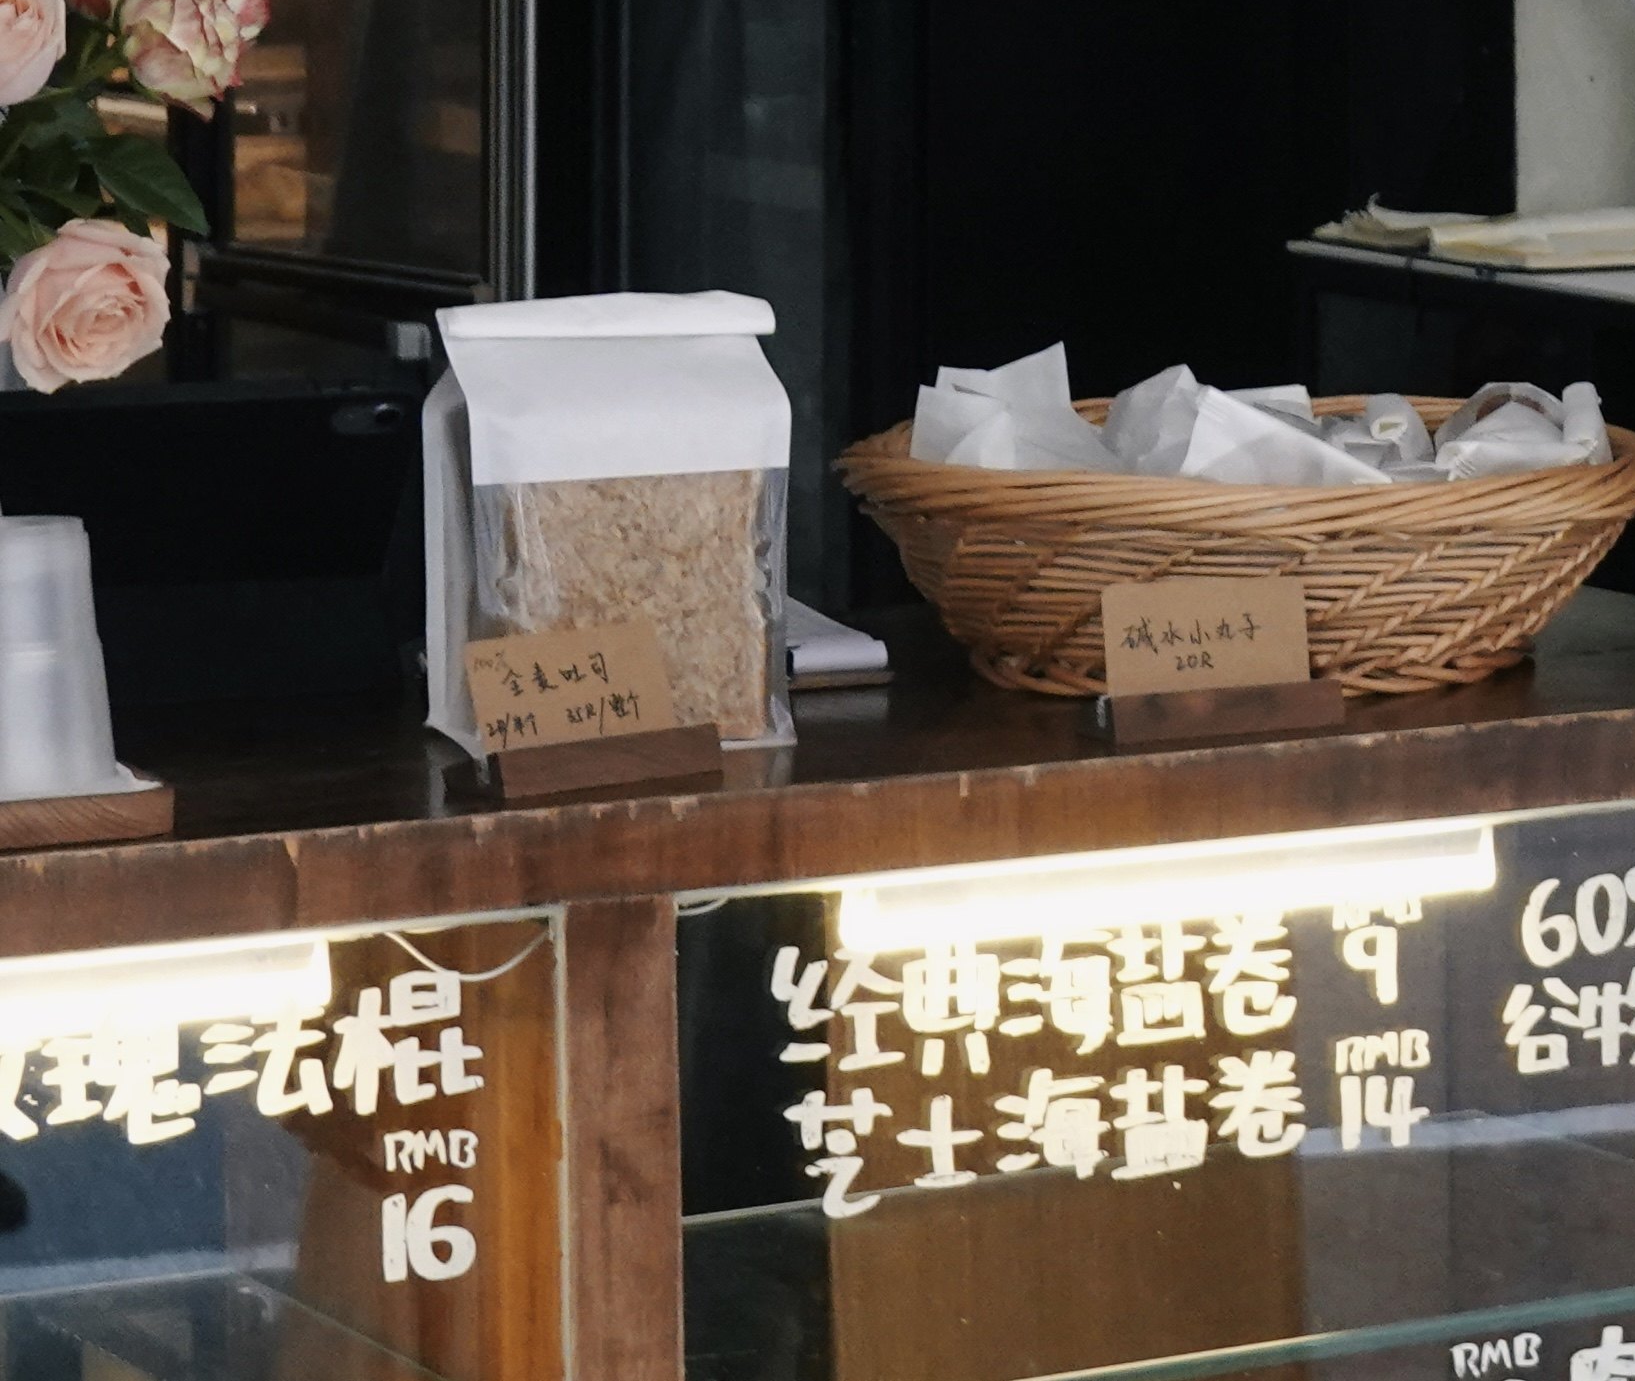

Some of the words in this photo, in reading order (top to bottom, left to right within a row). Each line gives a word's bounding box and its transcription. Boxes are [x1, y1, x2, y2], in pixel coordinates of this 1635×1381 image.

[502, 652, 609, 697] 全麦吐司
[1176, 651, 1213, 671] 20R
[771, 908, 1298, 1076] 经典海盐卷
[1343, 924, 1398, 1004] 9
[1335, 1029, 1430, 1074] RMB
[383, 1129, 479, 1174] RMB
[783, 1050, 1306, 1219] 芝士海盐卷
[1340, 1075, 1429, 1151] 14
[381, 1184, 478, 1283] 16
[1450, 1331, 1542, 1379] RMB
